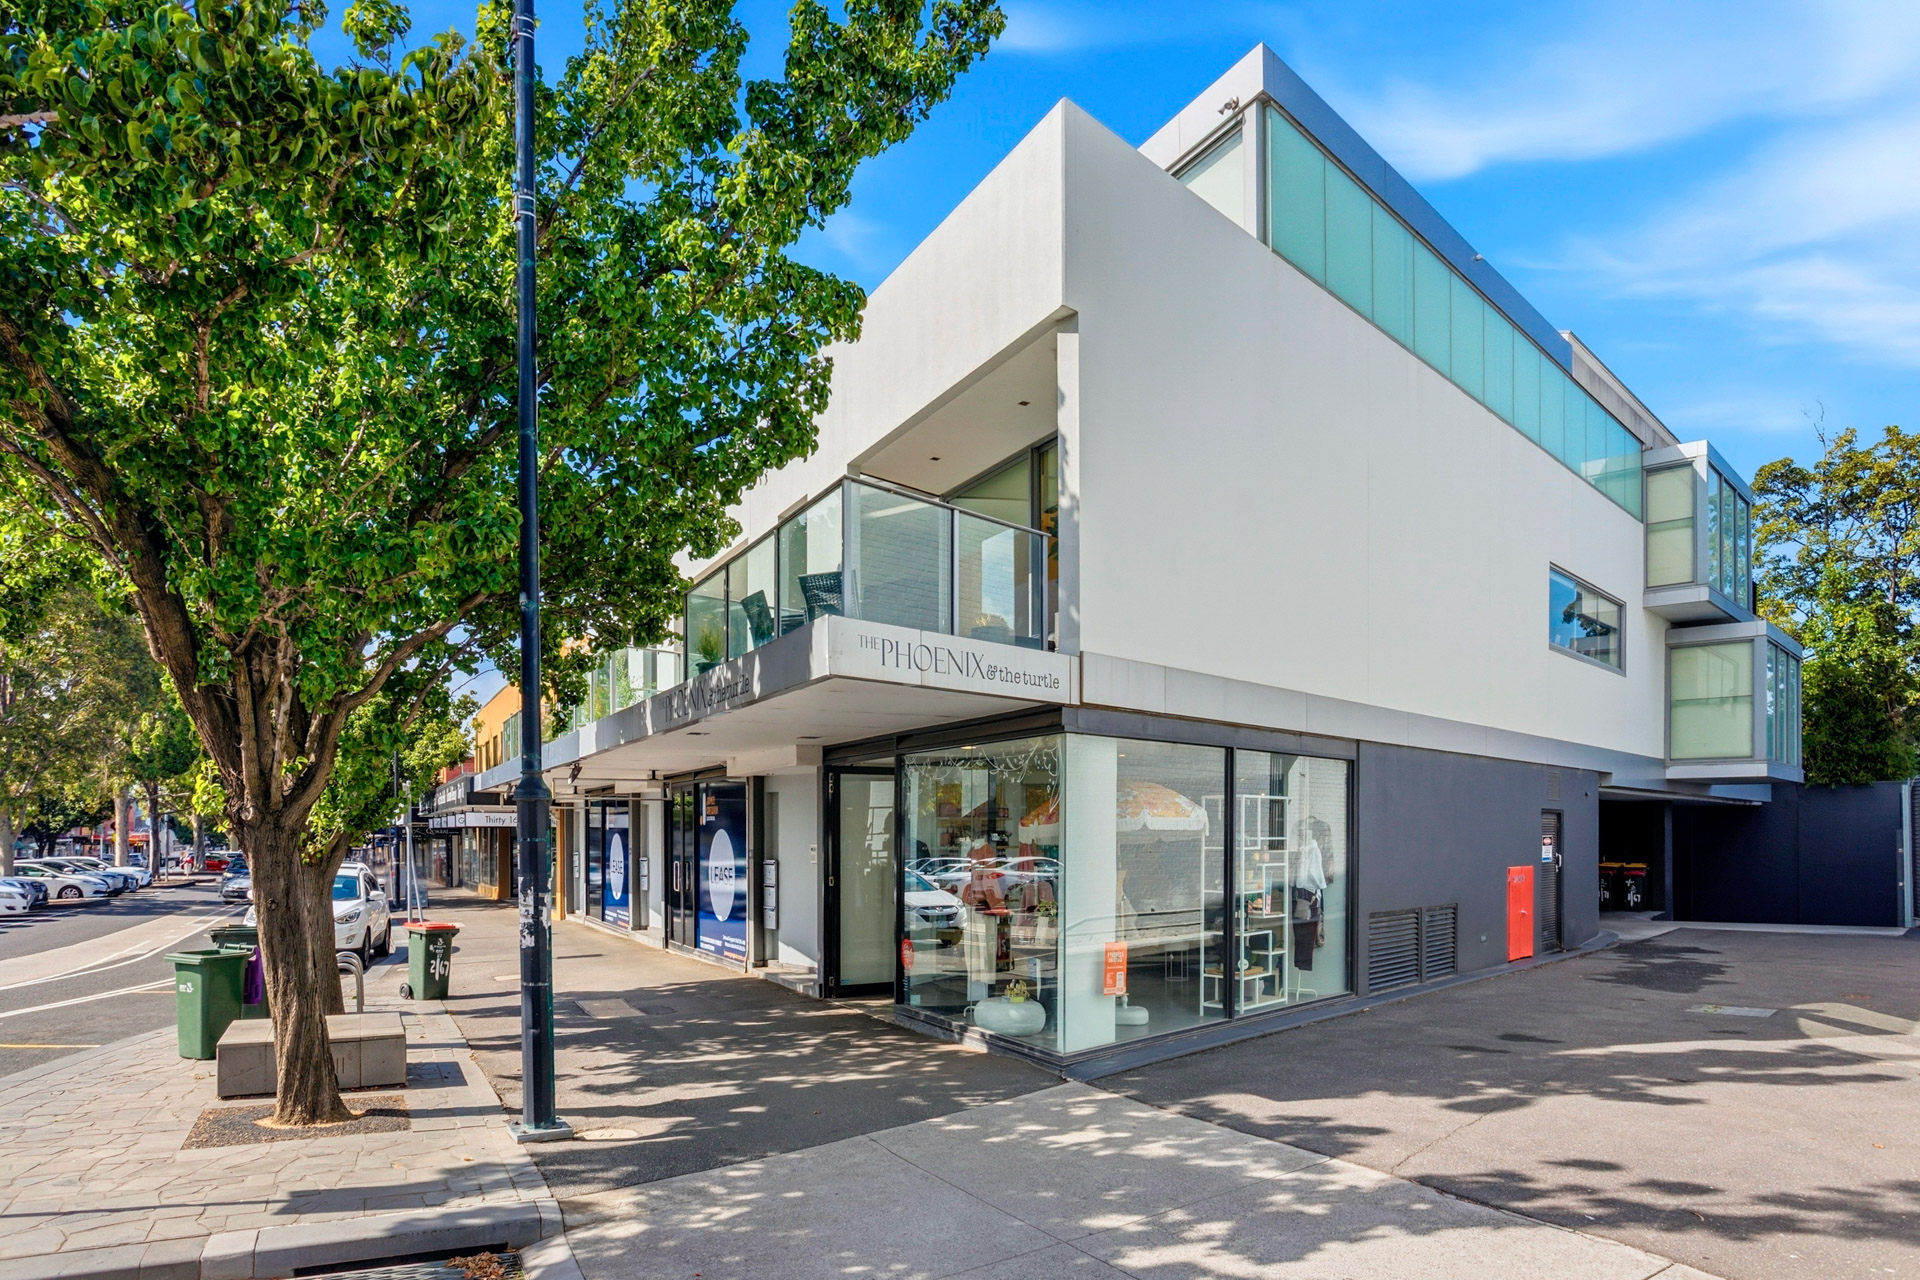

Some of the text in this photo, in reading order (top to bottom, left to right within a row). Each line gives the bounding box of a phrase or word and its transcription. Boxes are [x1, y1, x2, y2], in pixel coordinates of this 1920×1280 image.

[858, 634, 880, 650] THE
[881, 638, 985, 679] PHOENIX
[986, 664, 998, 680] &
[1022, 670, 1060, 689] turtle
[484, 815, 506, 825] Thirty
[610, 859, 623, 875] LEASE
[710, 866, 733, 886] LEASE
